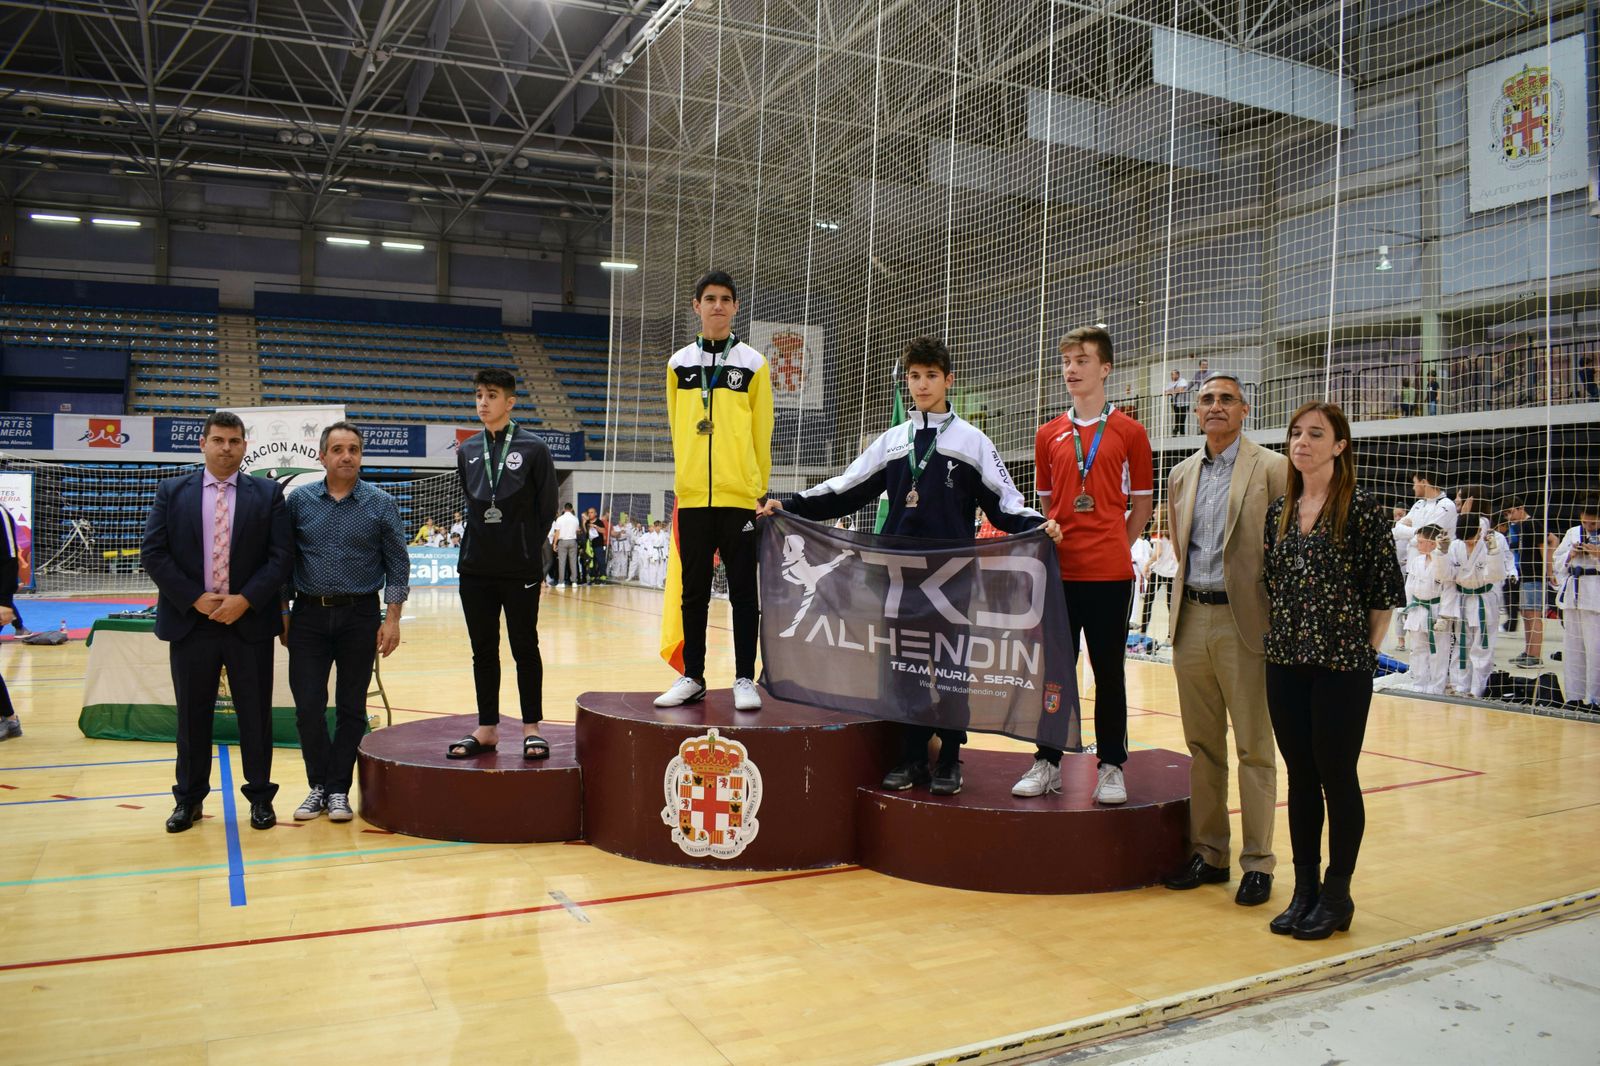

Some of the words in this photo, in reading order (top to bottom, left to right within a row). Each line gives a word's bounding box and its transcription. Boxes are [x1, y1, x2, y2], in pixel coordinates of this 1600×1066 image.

[171, 433, 185, 441] DE
[360, 430, 409, 439] EPORTES
[370, 438, 408, 446] ALMERIA
[239, 442, 288, 473] ERACION
[991, 450, 1010, 486] GIVOV
[859, 551, 1047, 630] TKD
[804, 614, 1041, 675] ALHENDÍN
[890, 661, 932, 676] TEAM
[934, 667, 979, 682] NURIA
[983, 674, 1036, 690] SERRA
[936, 684, 1008, 698] www.tkdalhendin.org
